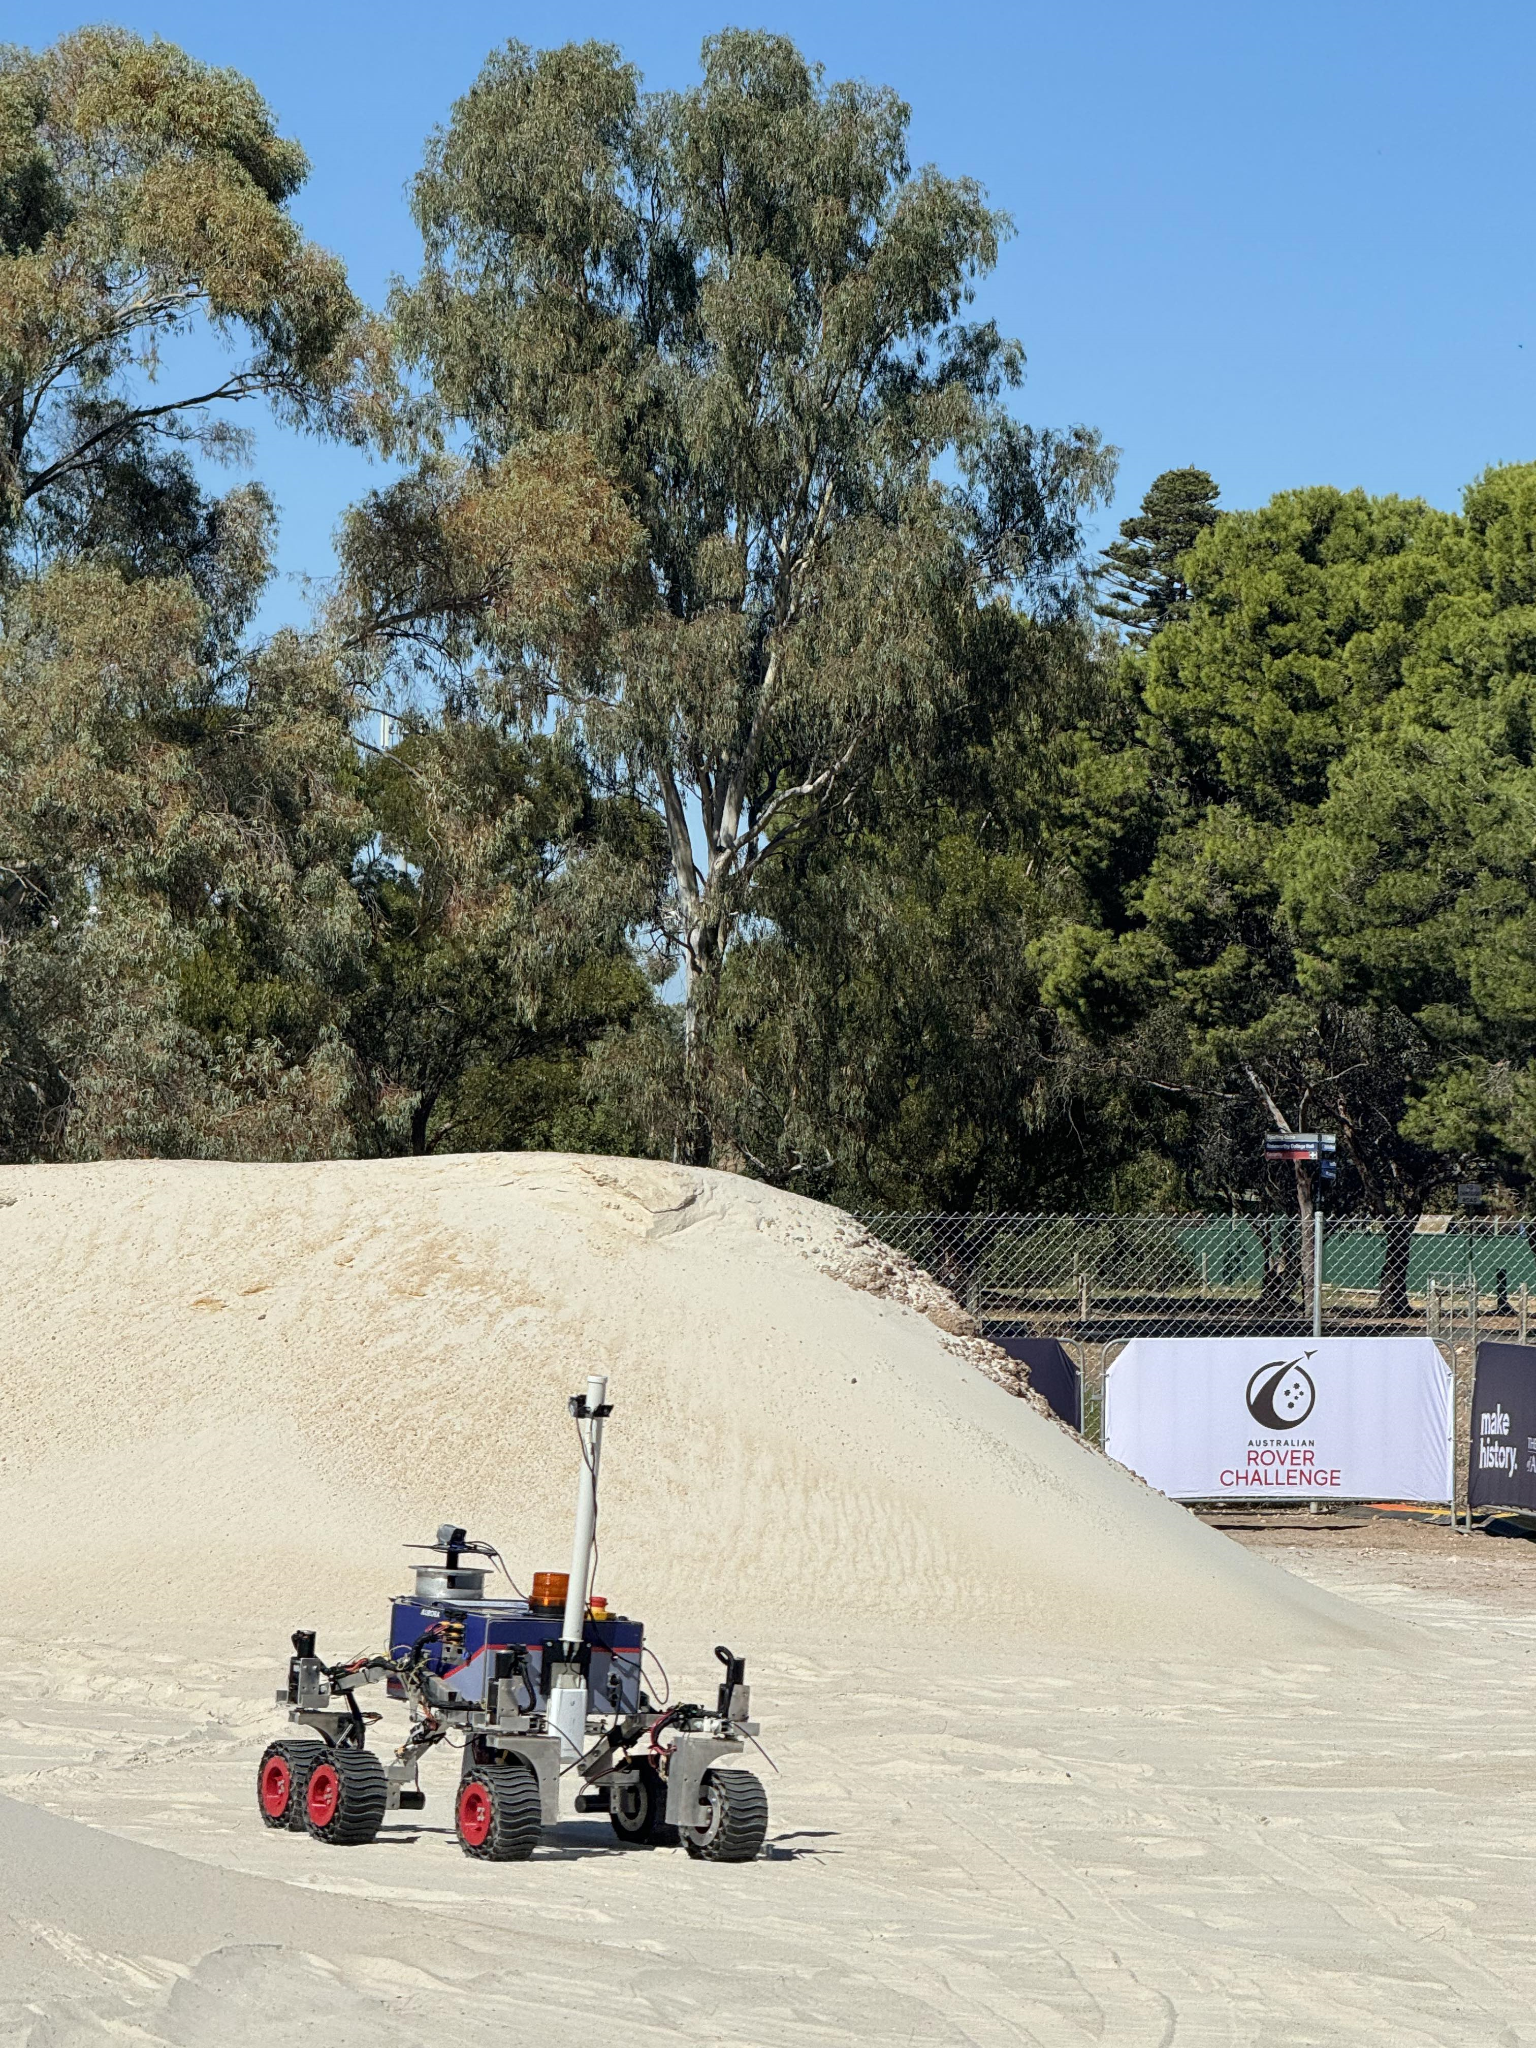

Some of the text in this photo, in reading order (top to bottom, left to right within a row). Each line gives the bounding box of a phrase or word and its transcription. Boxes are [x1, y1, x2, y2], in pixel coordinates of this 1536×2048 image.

[1480, 1403, 1510, 1436] make
[1247, 1439, 1315, 1447] AUSTRALIAN
[1247, 1450, 1315, 1466] ROVER
[1479, 1437, 1518, 1478] history.
[1220, 1469, 1341, 1486] CHALLENGE
